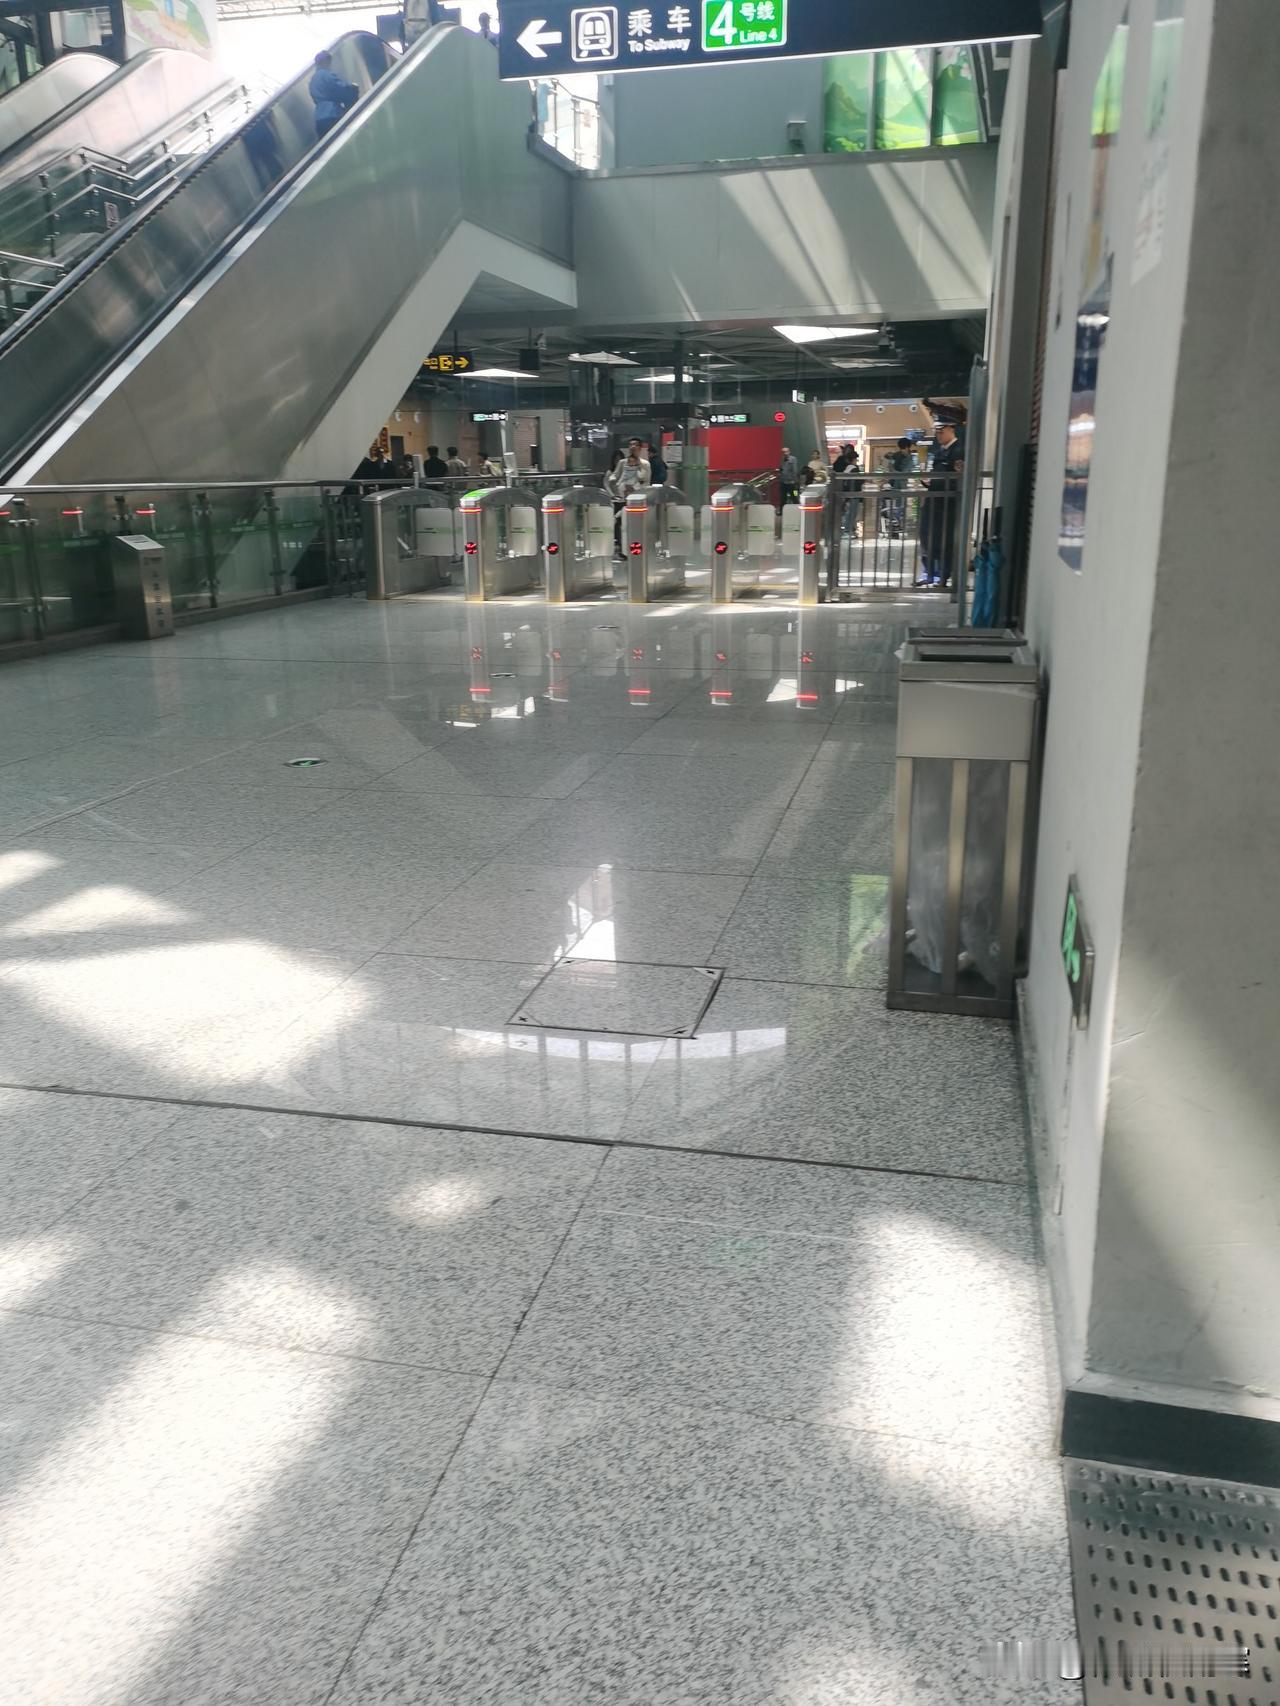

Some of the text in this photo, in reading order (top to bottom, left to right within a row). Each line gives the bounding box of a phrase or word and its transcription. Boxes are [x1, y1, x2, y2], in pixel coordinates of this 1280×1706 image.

[739, 28, 777, 43] Line 4
[627, 38, 691, 53] To Subway
